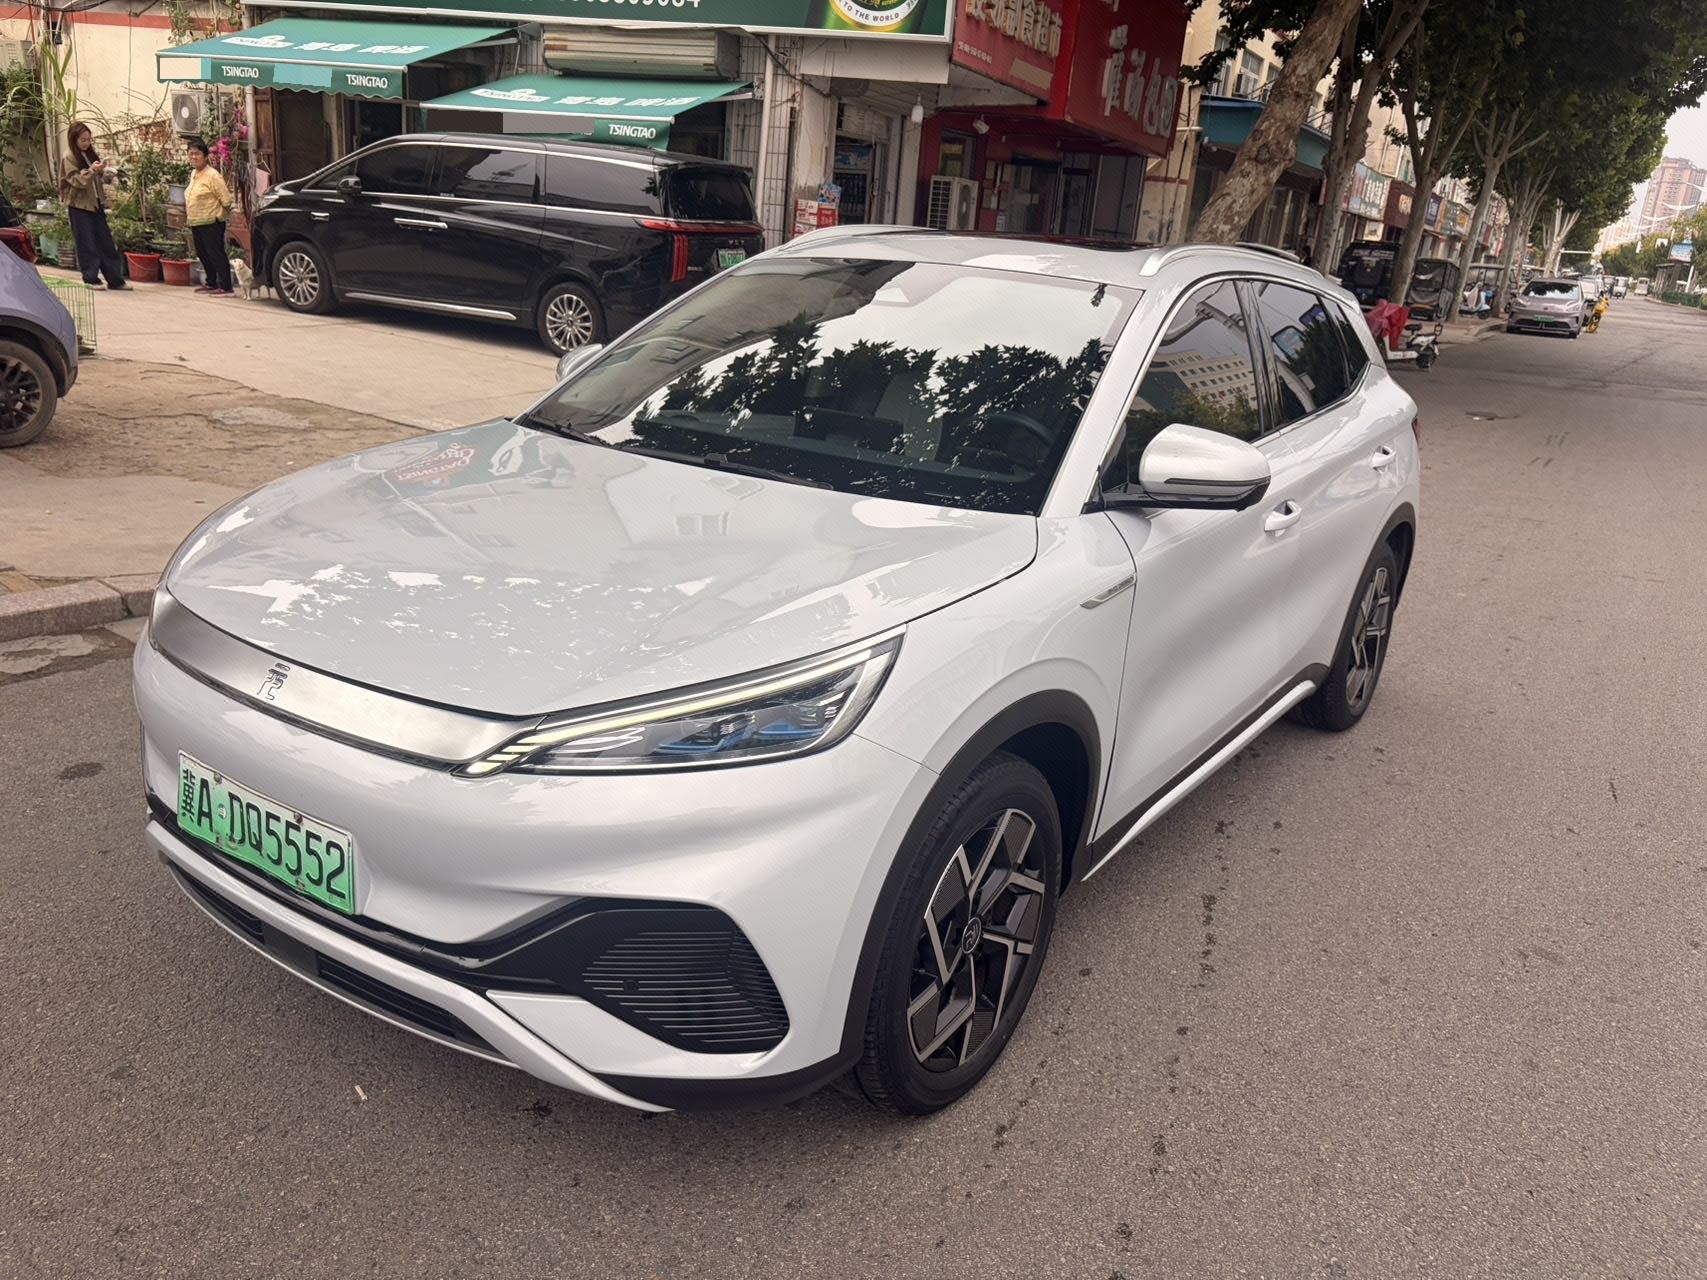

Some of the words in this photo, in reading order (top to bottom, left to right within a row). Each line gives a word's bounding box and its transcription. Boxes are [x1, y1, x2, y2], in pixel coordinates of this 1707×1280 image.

[855, 10, 870, 21] THE
[872, 12, 900, 22] WORLD
[221, 65, 259, 79] TSINGTAO
[346, 74, 388, 88] TSINGTAO
[608, 124, 657, 139] TSINGTAO
